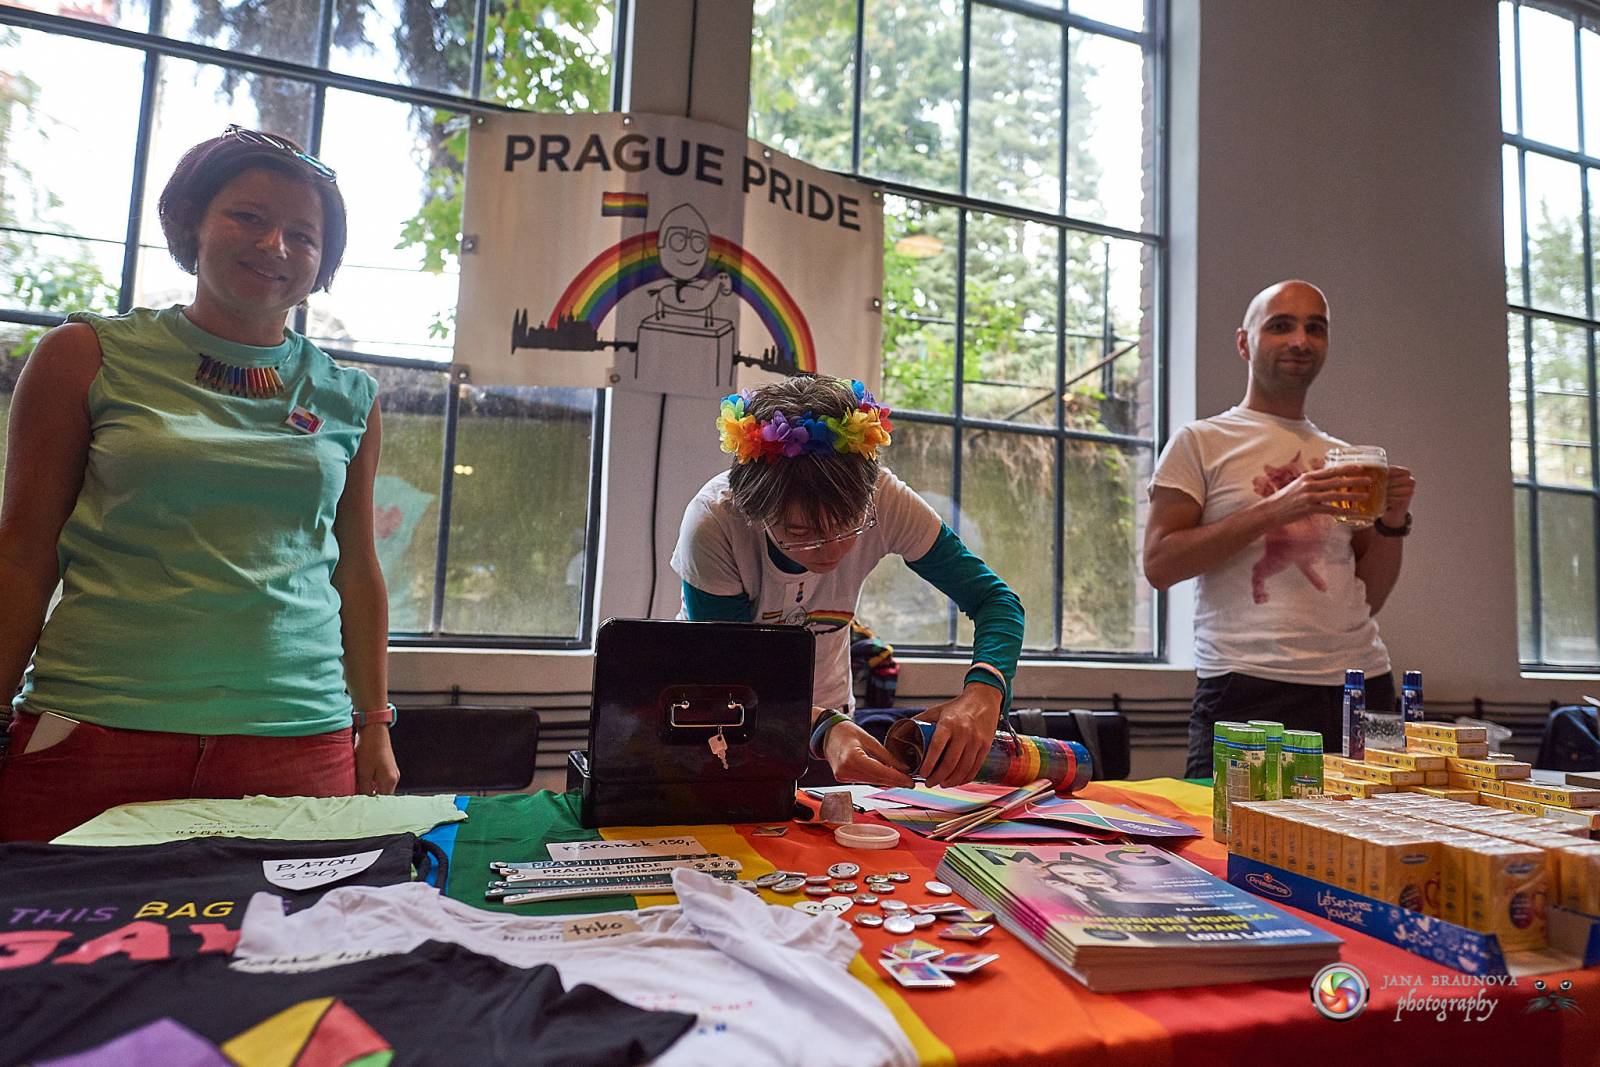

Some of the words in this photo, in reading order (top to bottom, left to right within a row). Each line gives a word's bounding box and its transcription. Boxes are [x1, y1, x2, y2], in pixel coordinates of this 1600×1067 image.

[504, 133, 724, 186] PRAGUE
[742, 156, 861, 232] PRIDE
[276, 857, 357, 871] BATOH
[543, 866, 610, 874] PRAGUE
[617, 862, 663, 870] PRIDE
[975, 848, 1171, 868] MAG
[8, 906, 120, 924] THIS
[133, 901, 236, 919] BAG
